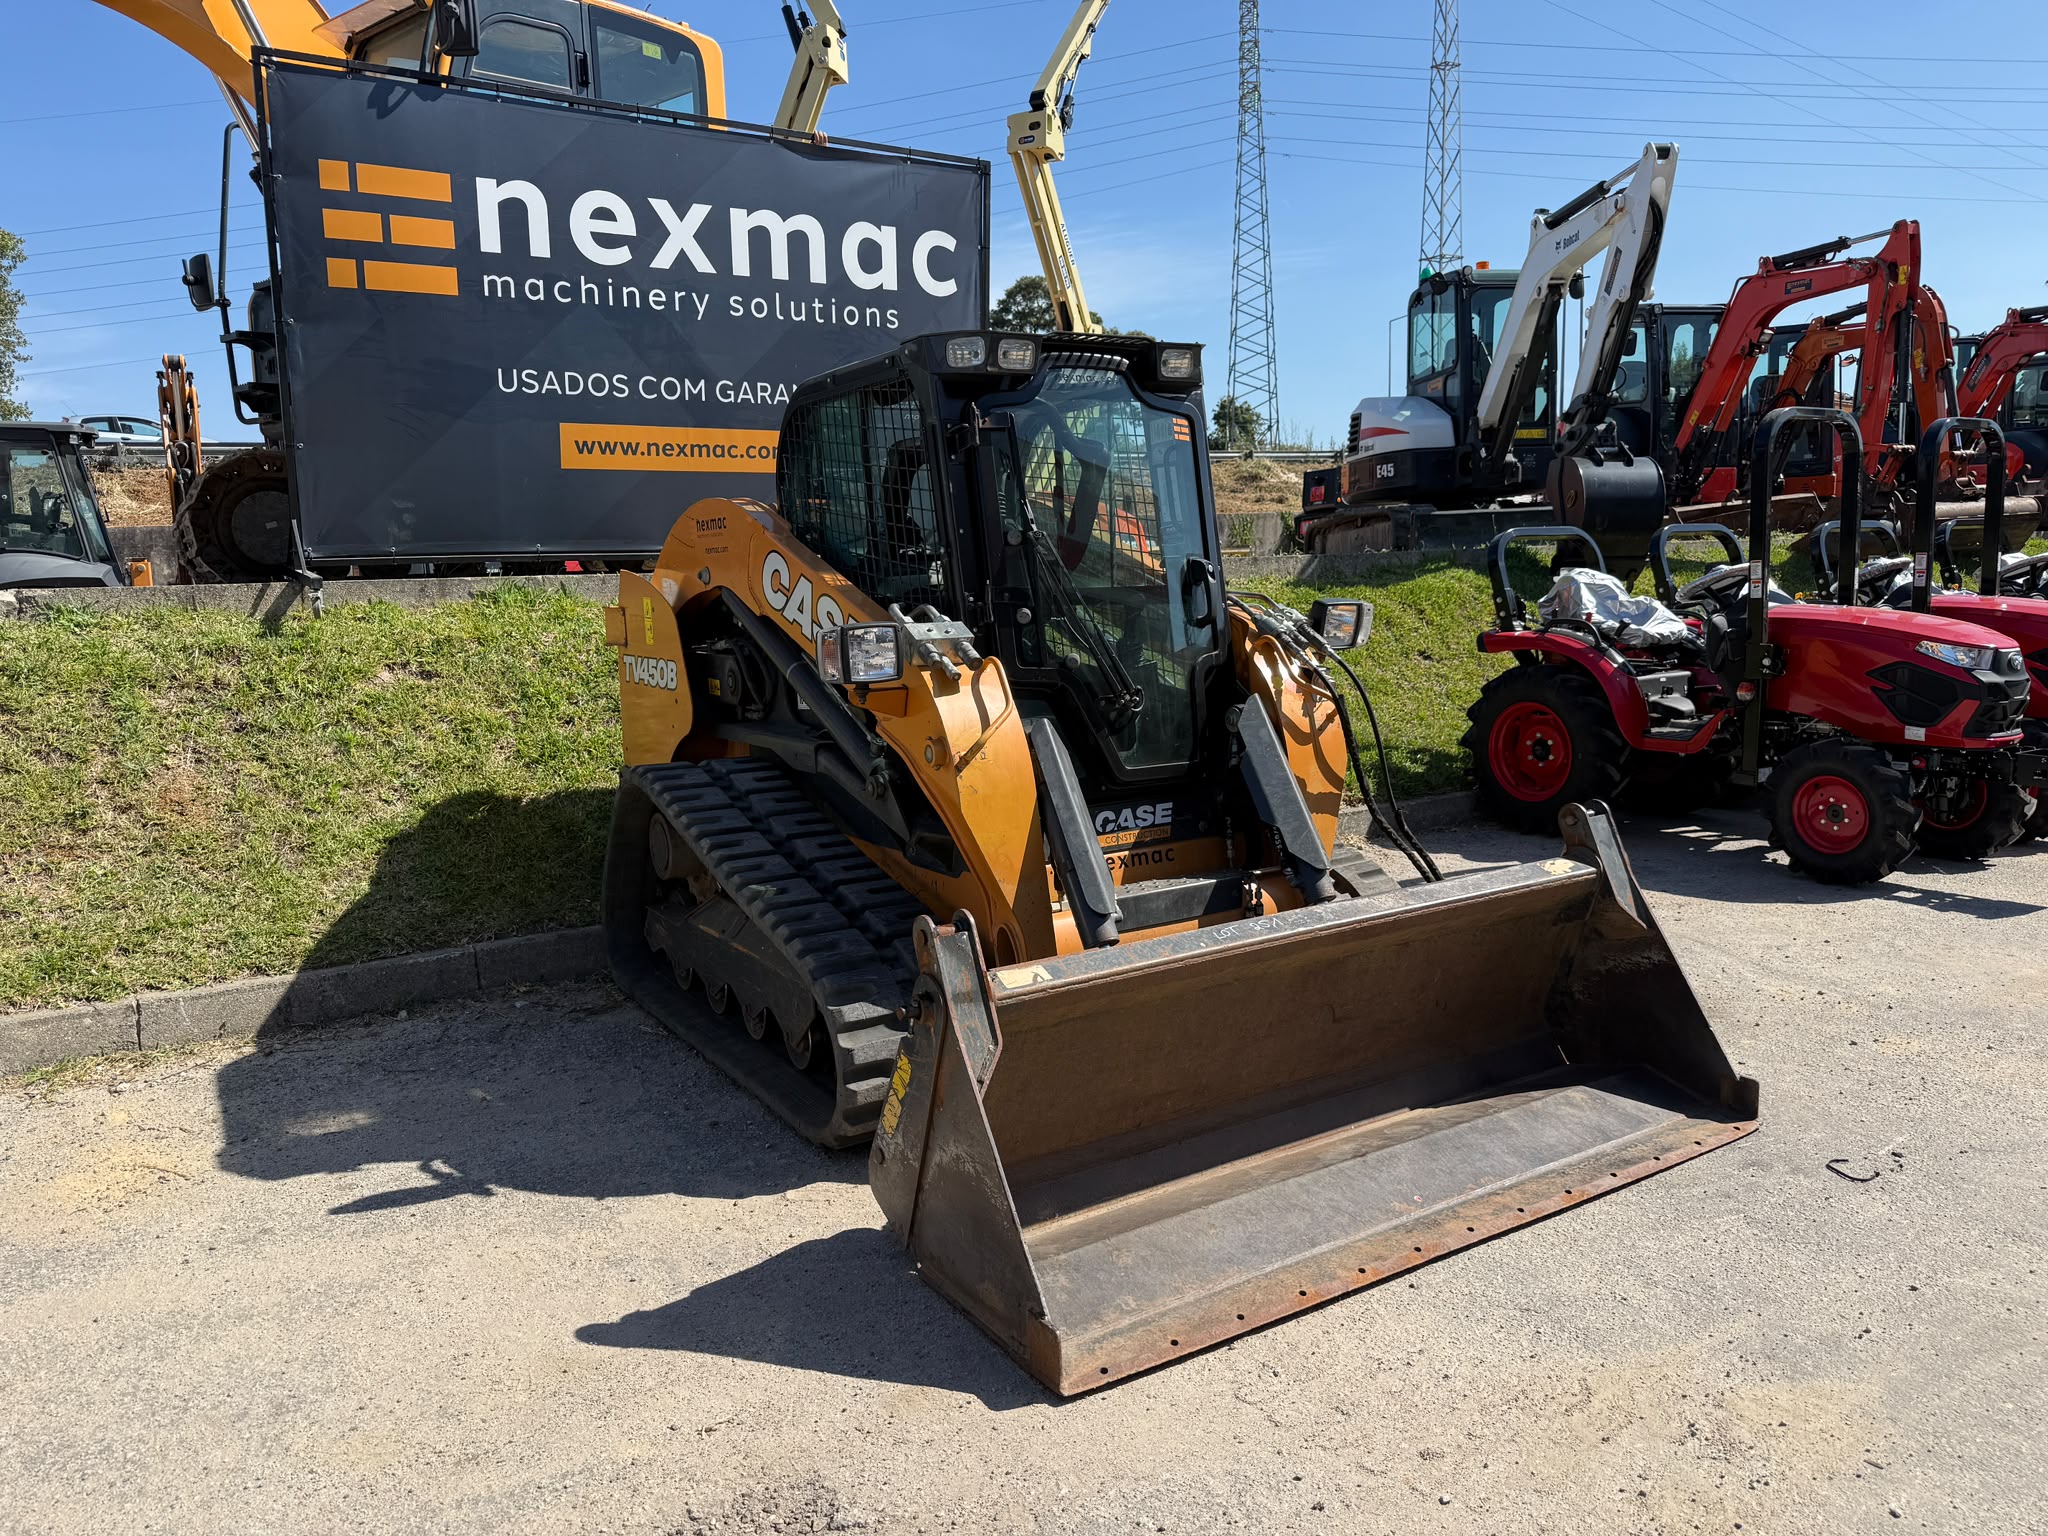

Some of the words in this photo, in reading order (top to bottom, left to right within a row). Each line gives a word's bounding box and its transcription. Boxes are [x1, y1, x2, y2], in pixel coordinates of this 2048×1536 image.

[476, 176, 958, 297] nexmac
[483, 274, 710, 321] machinery
[729, 292, 899, 329] solutions
[497, 368, 630, 398] USADOS
[638, 375, 706, 402] COM
[715, 380, 798, 405] GARA
[1376, 463, 1395, 479] E45
[696, 516, 727, 533] nexmac
[762, 550, 859, 644] CAS
[623, 654, 678, 691] TV450B
[1095, 802, 1173, 832] CASE
[1105, 827, 1169, 844] CONSTRUCTION
[1105, 847, 1175, 871] exmac
[1213, 924, 1239, 940] LOT
